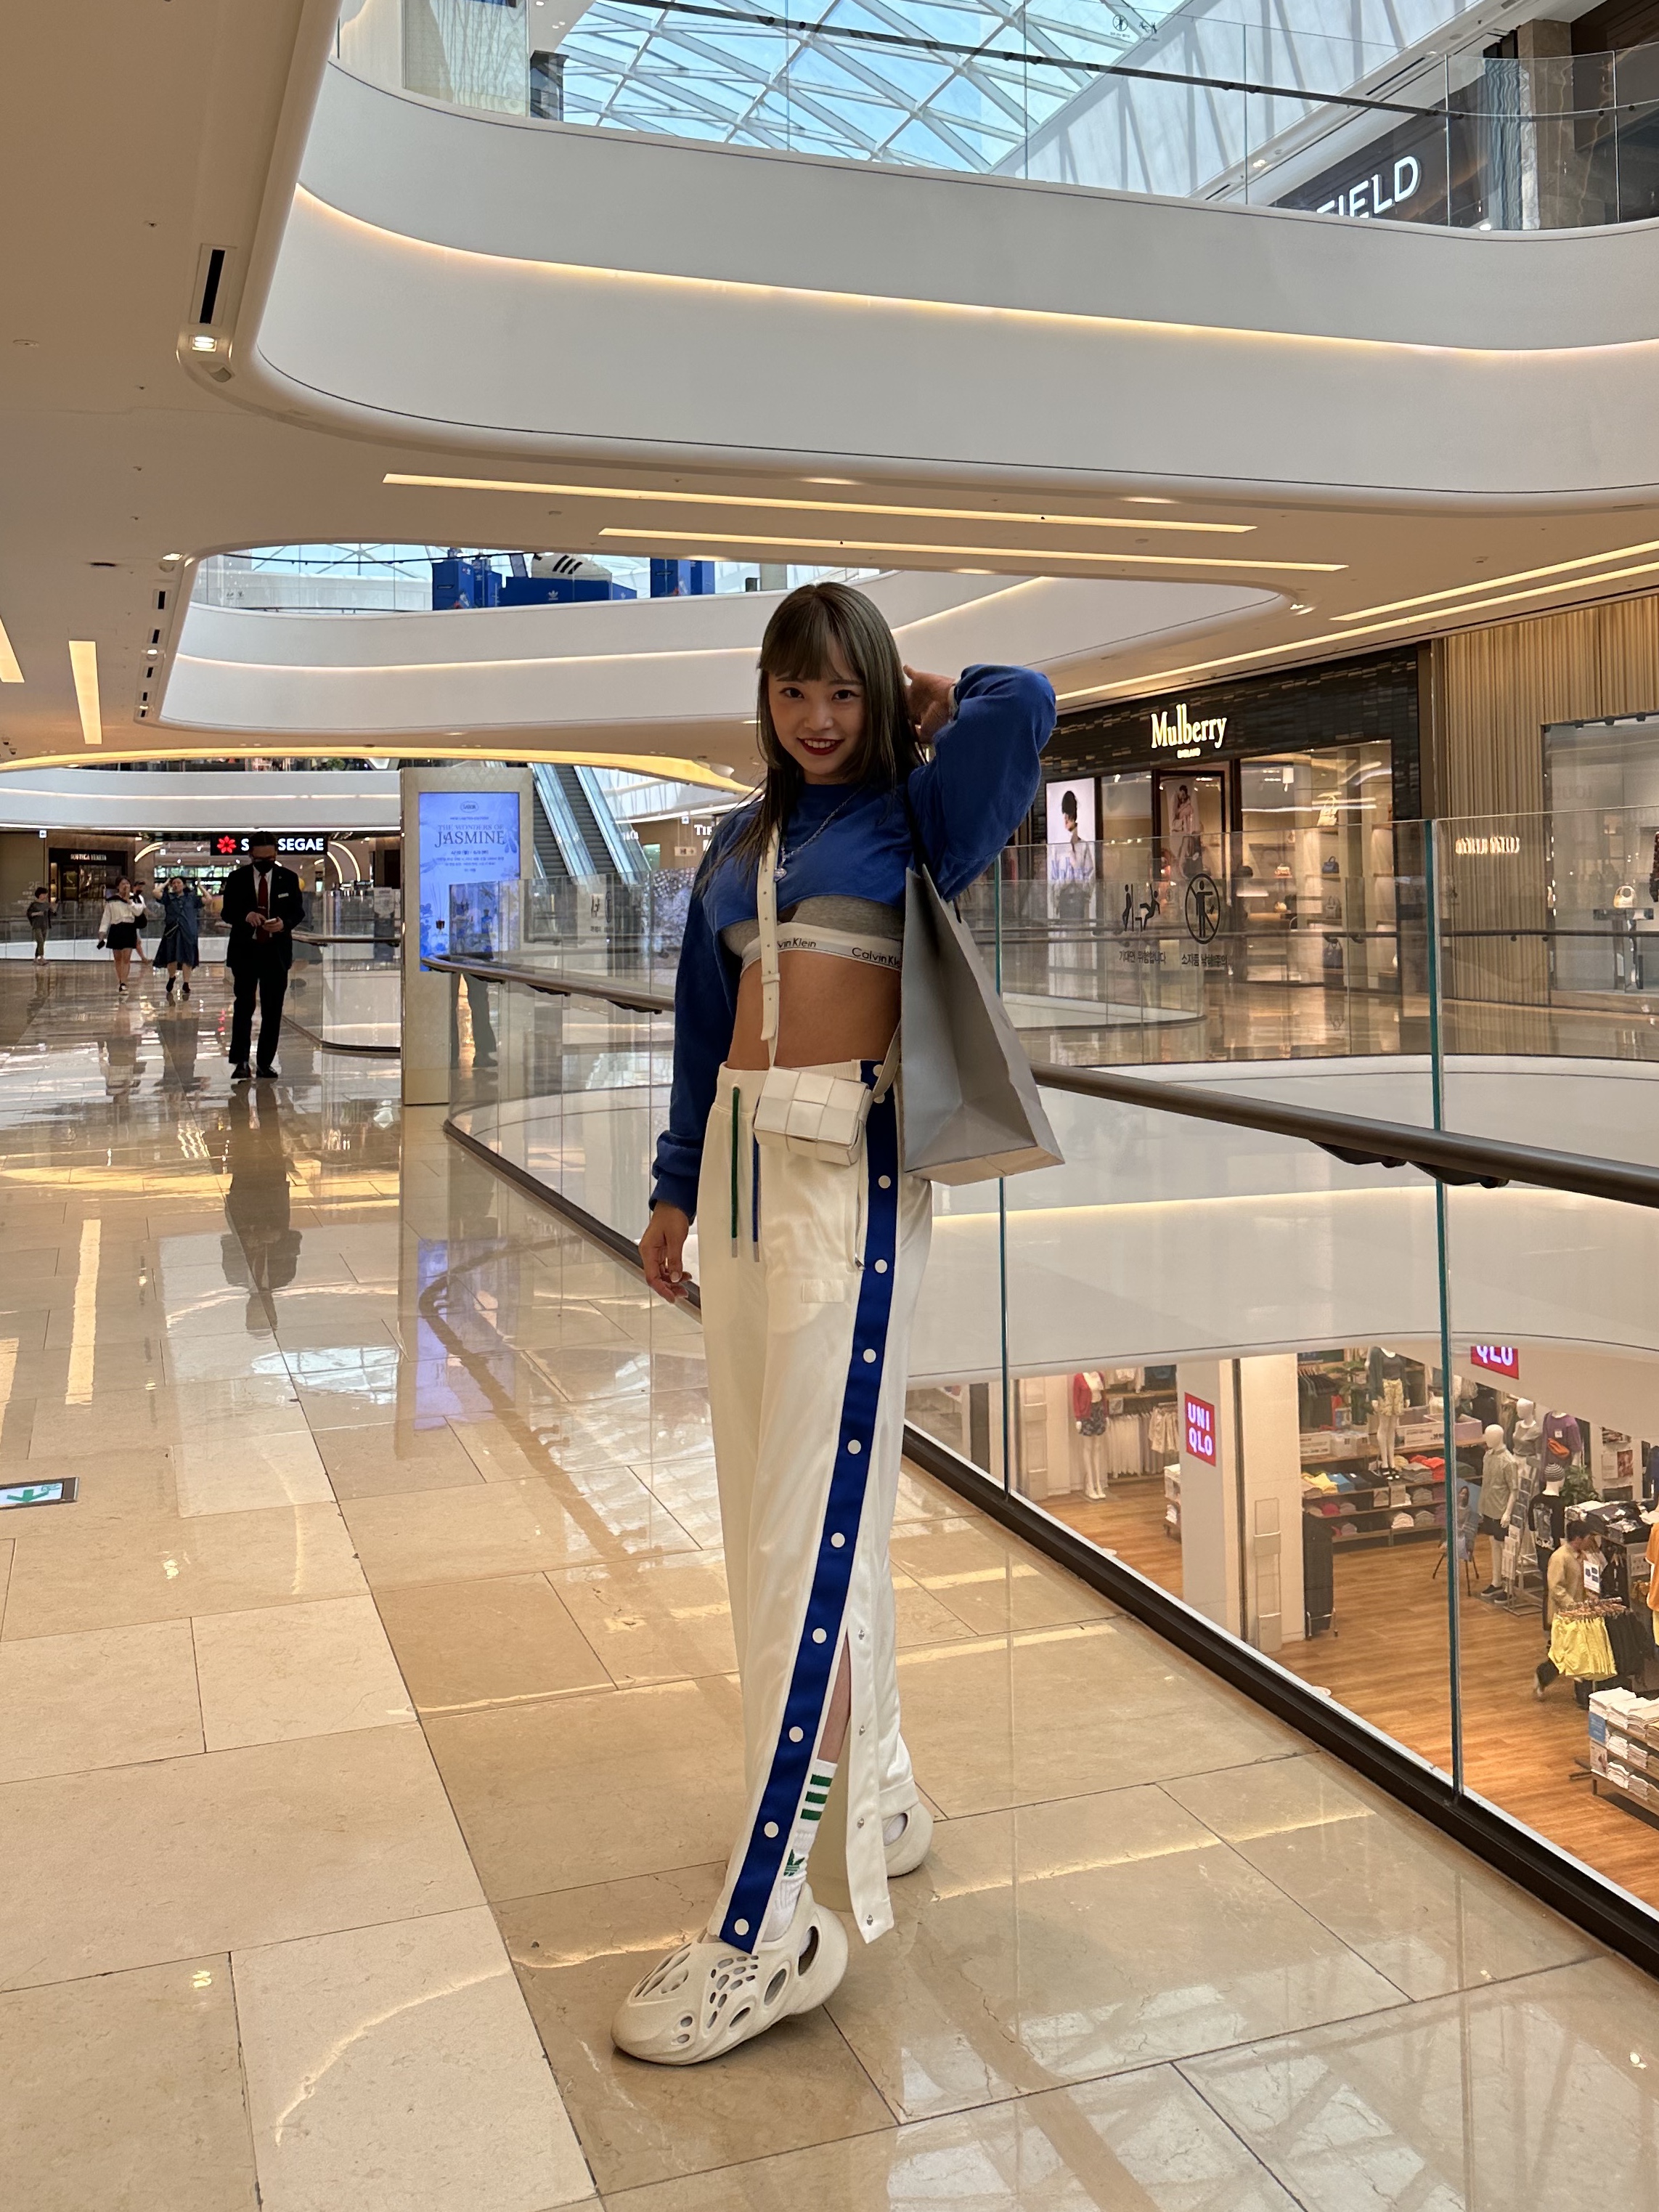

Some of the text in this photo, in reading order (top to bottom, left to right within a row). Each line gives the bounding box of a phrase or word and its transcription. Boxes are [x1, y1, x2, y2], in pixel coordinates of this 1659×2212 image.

[1151, 703, 1227, 749] Mulberry
[434, 830, 506, 848] JASMINE
[793, 938, 817, 948] Klein
[852, 947, 887, 964] Calvin
[1187, 1402, 1210, 1431] UNI
[1189, 1427, 1212, 1456] QLO
